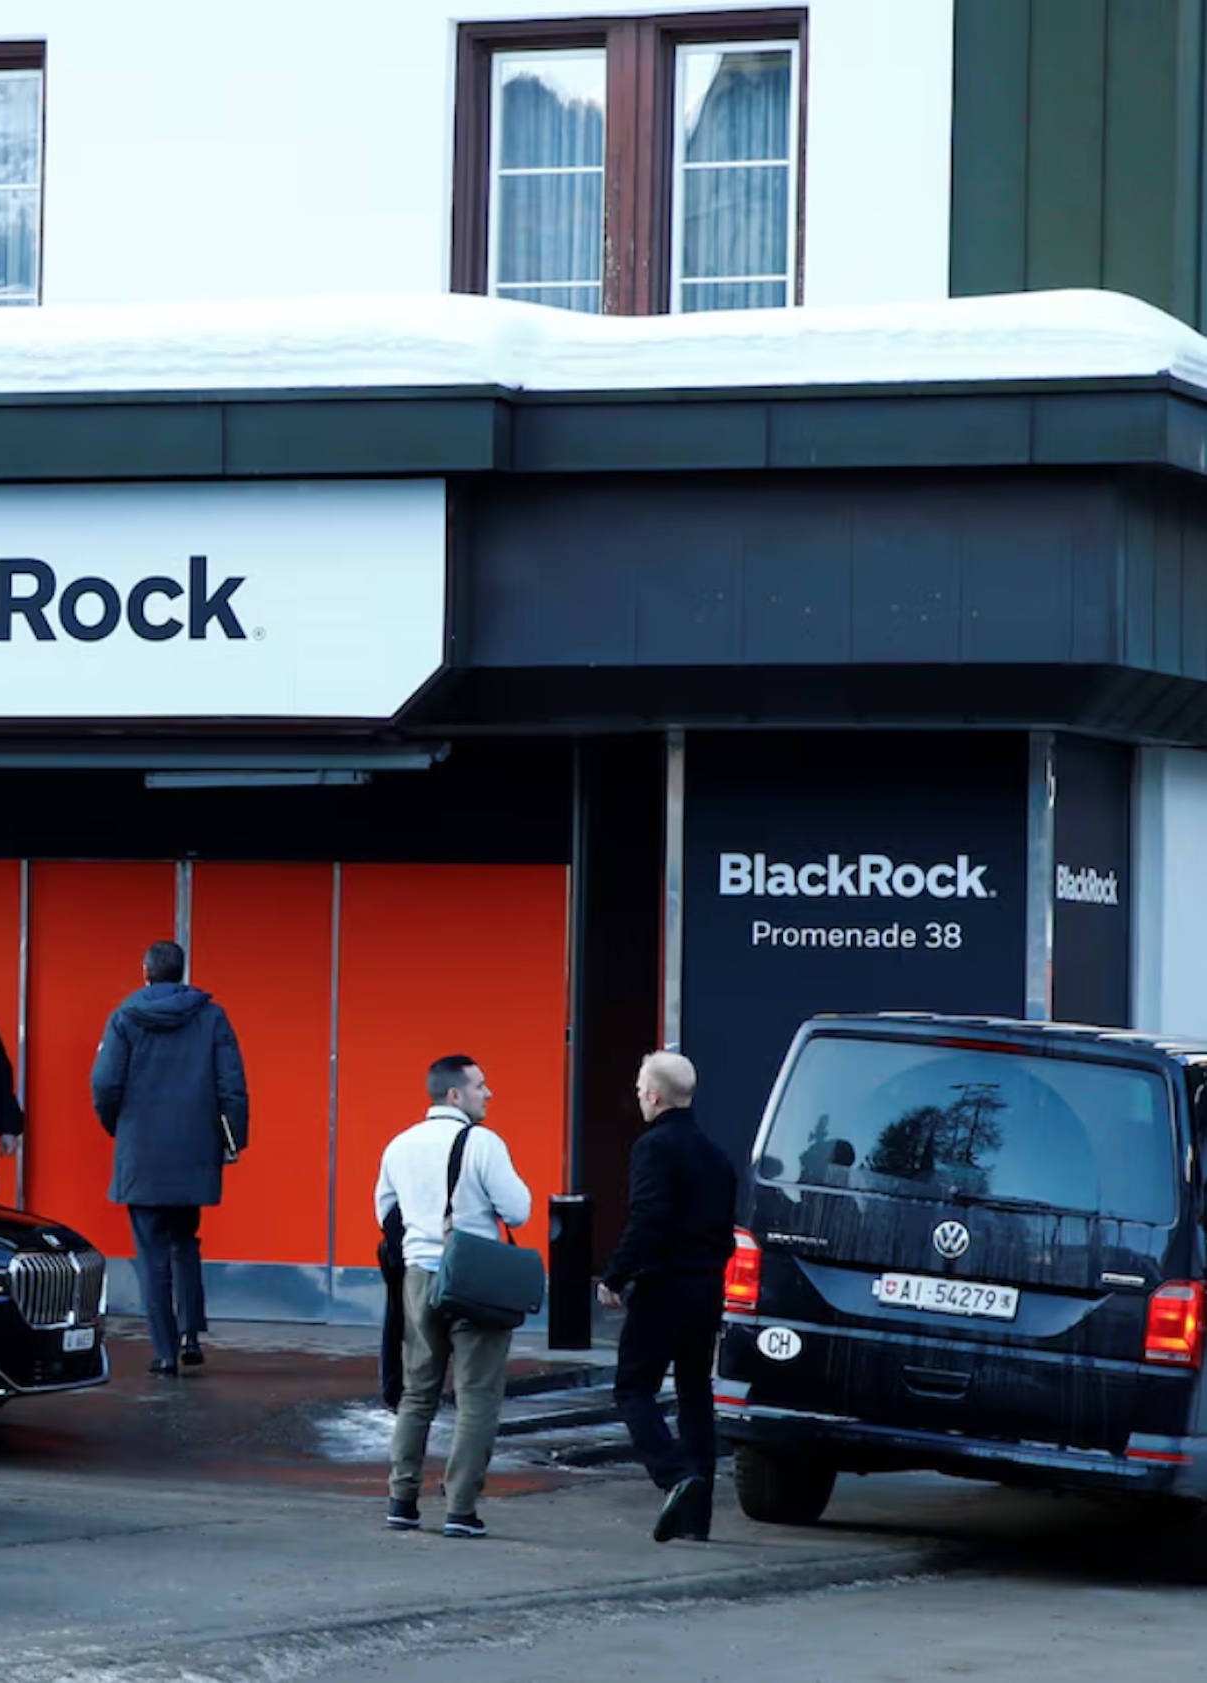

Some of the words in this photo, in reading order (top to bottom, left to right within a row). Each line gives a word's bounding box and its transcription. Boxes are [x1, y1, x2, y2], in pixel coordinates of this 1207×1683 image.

[1056, 864, 1119, 906] BlackRock
[751, 920, 917, 949] Promenade
[924, 923, 963, 949] 38
[767, 1330, 791, 1355] CH
